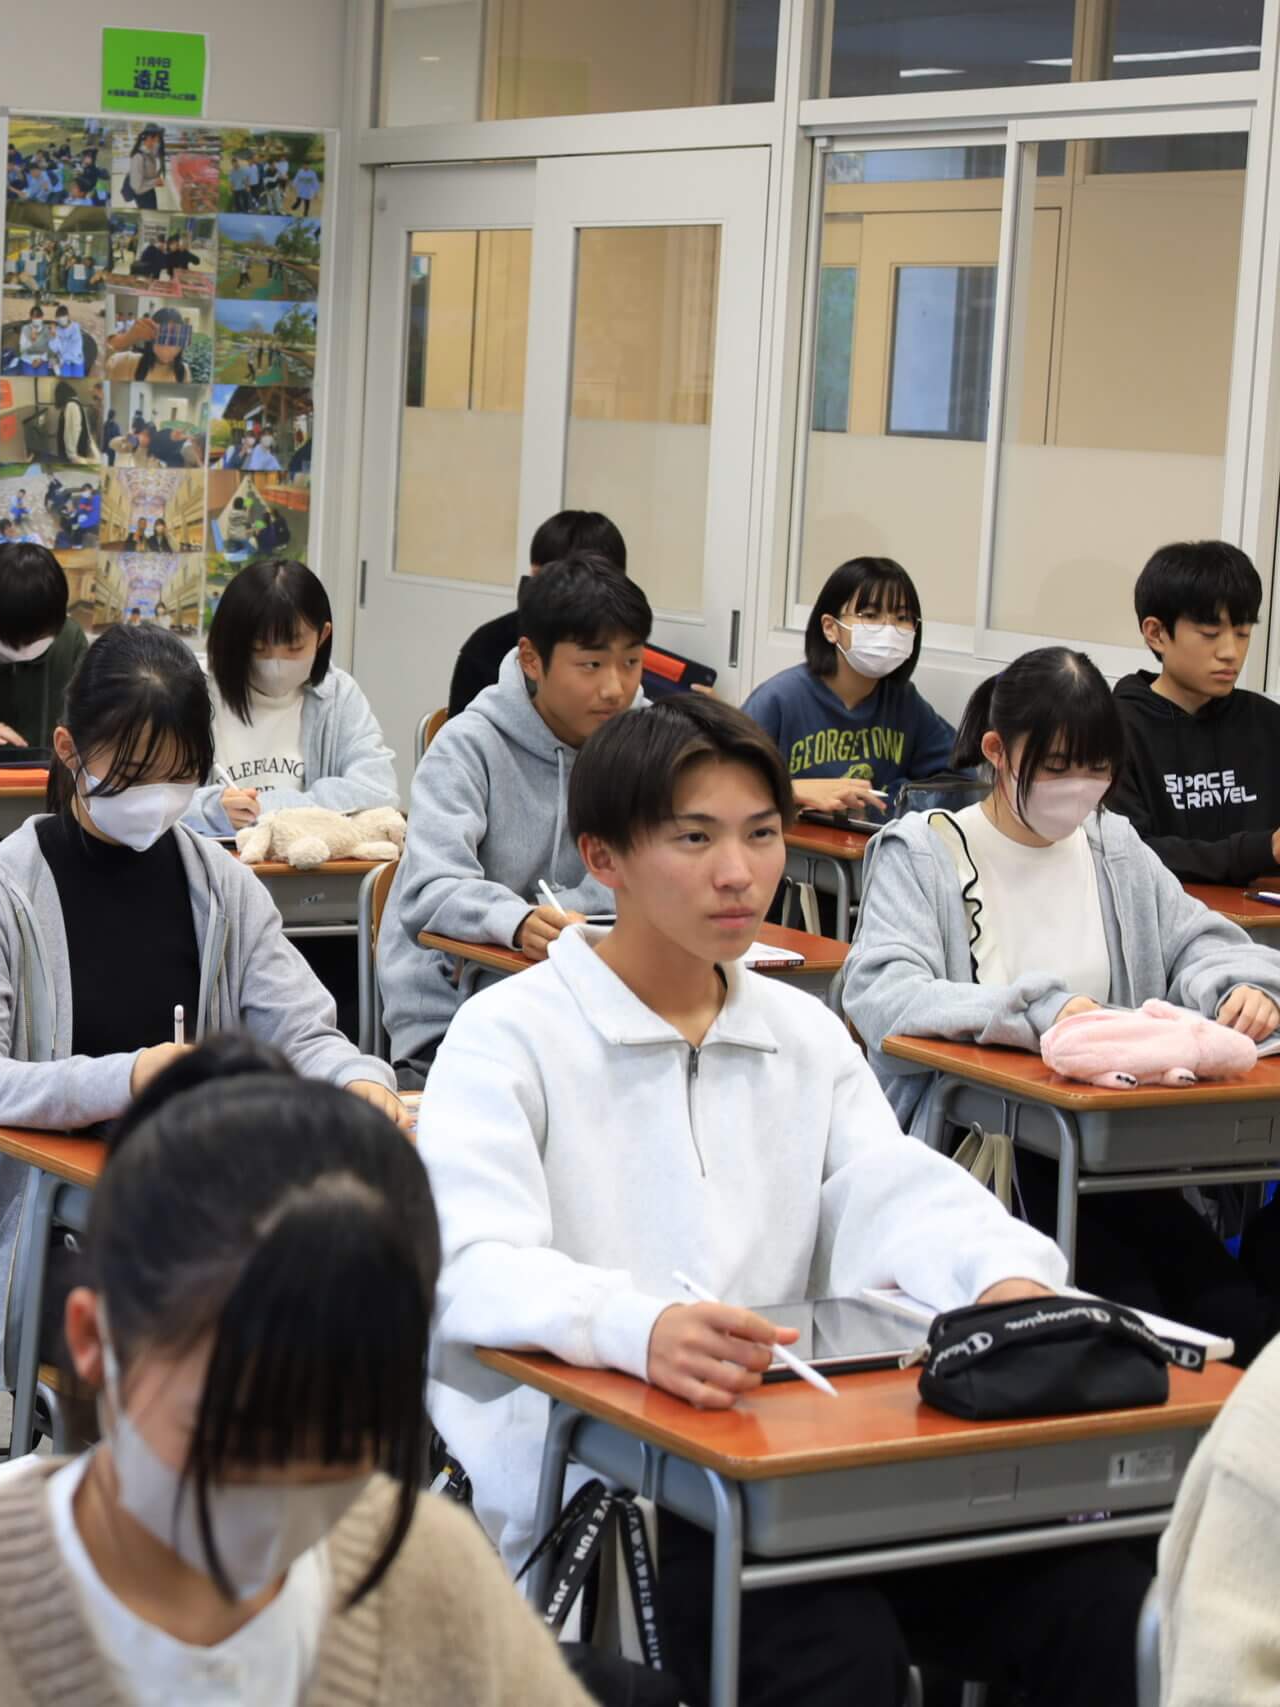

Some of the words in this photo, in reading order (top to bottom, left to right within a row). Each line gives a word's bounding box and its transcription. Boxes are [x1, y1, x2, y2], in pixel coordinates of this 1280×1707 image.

[133, 69, 171, 92] 遠足
[790, 726, 905, 775] GEORGETOWN
[1163, 769, 1236, 793] SPACE
[1171, 786, 1258, 810] TRAVEL
[1005, 1306, 1112, 1331] Champion
[1117, 1456, 1125, 1476] 1
[573, 1523, 600, 1561] FUN
[543, 1578, 570, 1625] JUST
